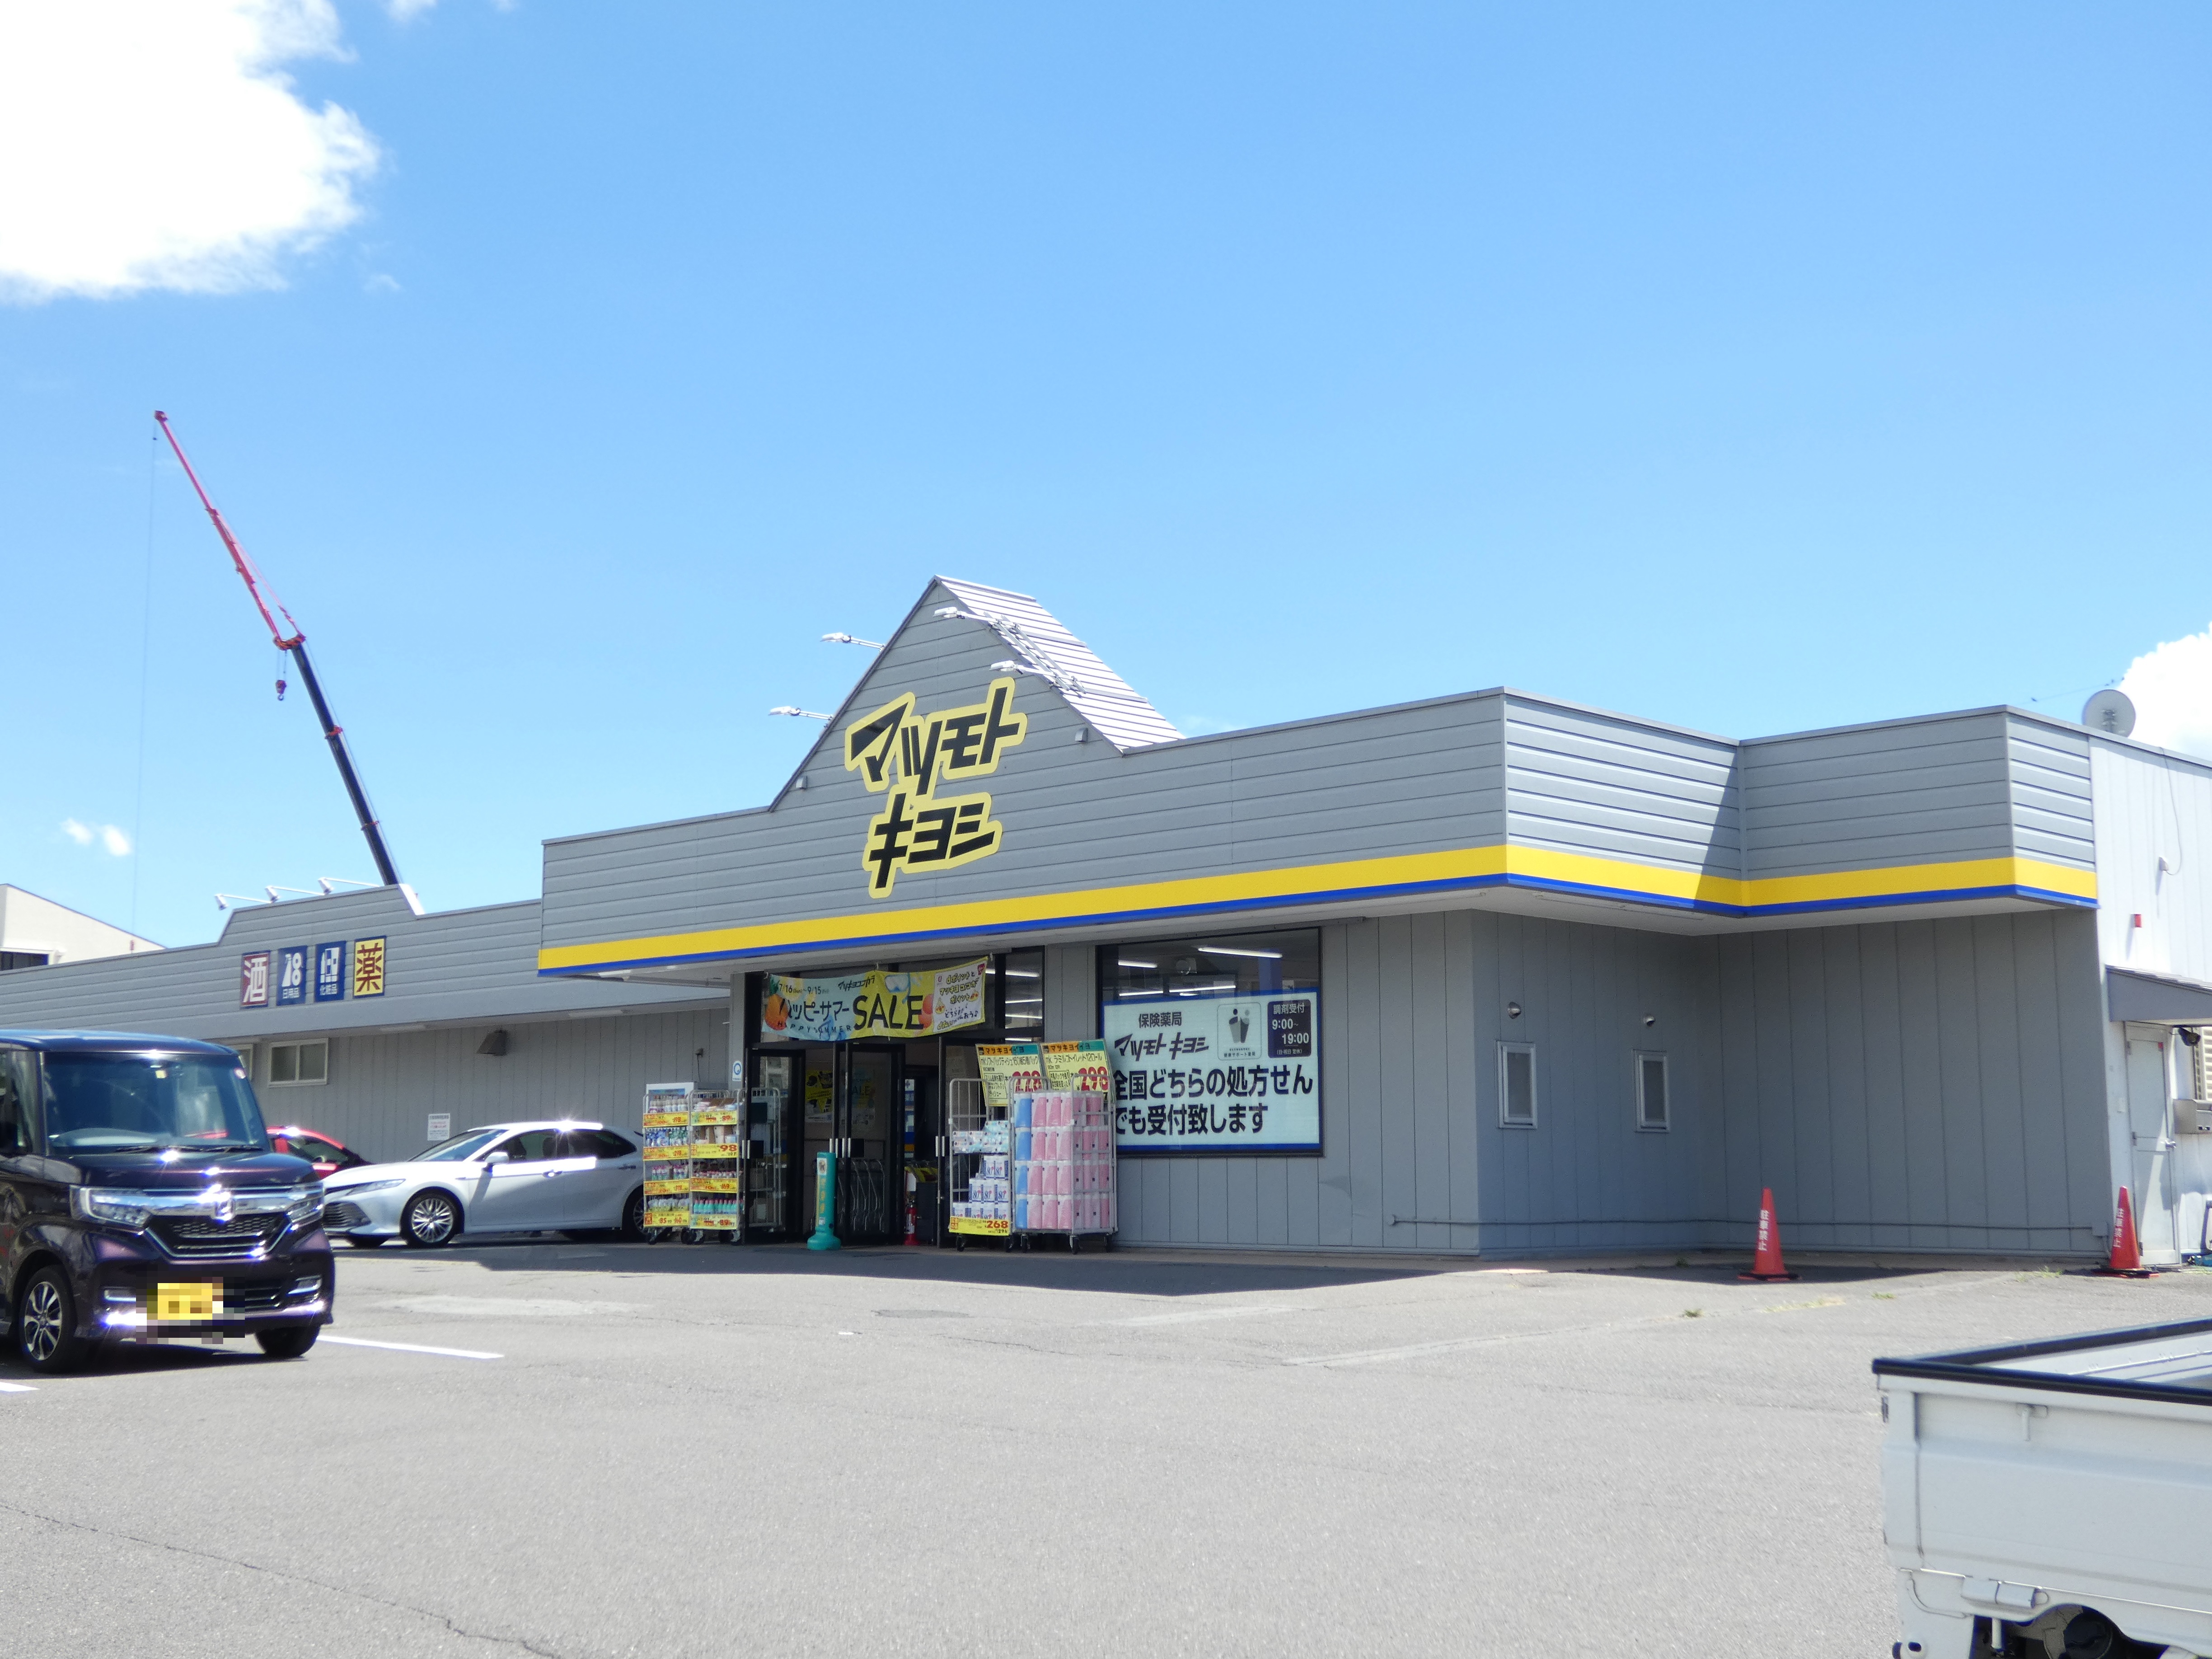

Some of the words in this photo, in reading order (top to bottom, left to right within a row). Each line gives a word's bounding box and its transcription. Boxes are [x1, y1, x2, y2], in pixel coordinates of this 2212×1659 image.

[851, 686, 1021, 796] マツモト
[868, 792, 995, 889] キヨシ
[242, 956, 267, 1003] 酒
[356, 942, 383, 993] 薬
[282, 988, 300, 999] 日用品
[320, 983, 338, 996] 化粧品
[853, 993, 925, 1031] SALE
[1138, 1012, 1182, 1028] 保険薬局
[1273, 1003, 1305, 1015] 調剤受付
[1282, 1032, 1309, 1045] 19:00
[1113, 1064, 1313, 1101] 全国どちらの処方せん
[1115, 1103, 1268, 1136] でも受付致します
[986, 1220, 1009, 1229] 268
